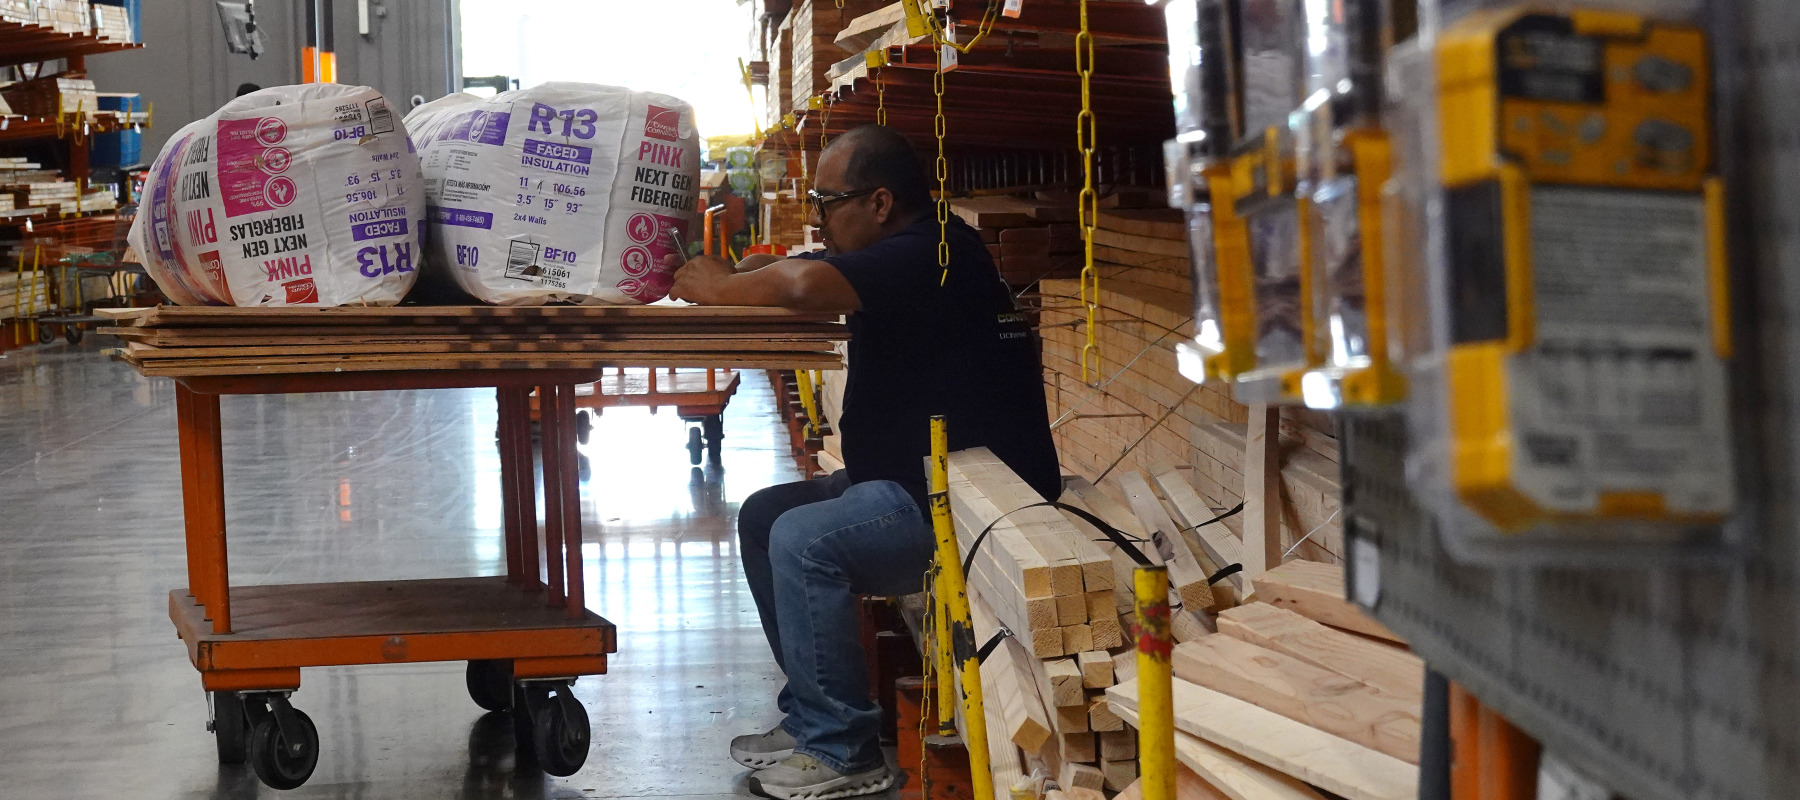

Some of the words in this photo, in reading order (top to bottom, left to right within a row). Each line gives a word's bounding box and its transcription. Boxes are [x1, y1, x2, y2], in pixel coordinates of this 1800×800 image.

[528, 102, 598, 139] R13
[334, 125, 365, 140] BF10
[371, 152, 388, 162] Walls
[536, 143, 579, 159] FACED
[638, 140, 683, 168] PINK
[521, 155, 589, 176] INSULATION
[519, 176, 529, 188] 11
[553, 183, 586, 197] 106.56
[635, 166, 669, 187] NEXT
[346, 190, 377, 203] 106.56
[349, 207, 406, 223] INSULATION
[513, 213, 527, 222] 2x4
[528, 215, 547, 226] Walls
[229, 213, 305, 242] FIBERGLAS
[365, 221, 400, 236] FACED
[243, 239, 269, 259] GEN
[273, 233, 308, 253] NEXT
[357, 242, 414, 278] R13
[456, 244, 479, 267] BF10
[543, 246, 577, 263] BF10
[263, 254, 313, 282] PINK
[542, 266, 571, 279] 615061
